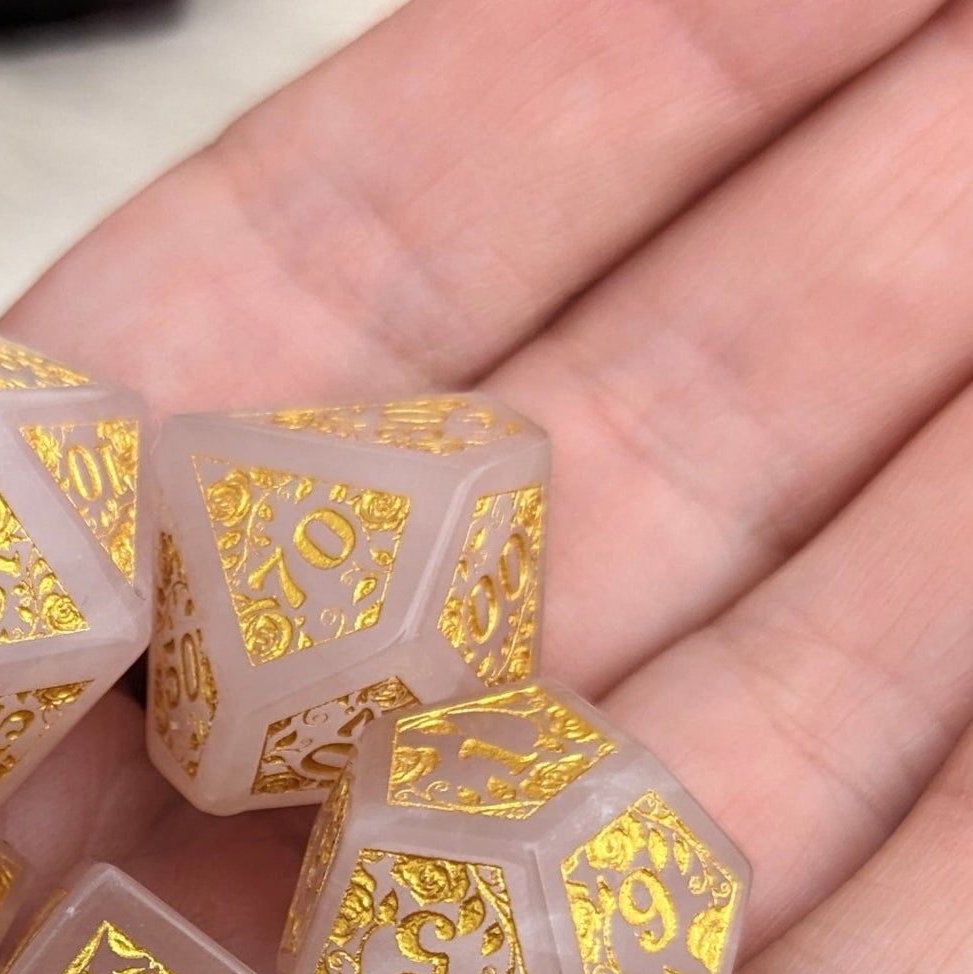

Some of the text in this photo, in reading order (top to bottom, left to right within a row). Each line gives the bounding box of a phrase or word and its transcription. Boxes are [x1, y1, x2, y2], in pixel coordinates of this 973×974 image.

[67, 444, 124, 500] 10
[247, 509, 356, 609] 70
[467, 533, 527, 643] 00
[459, 738, 539, 775] 1
